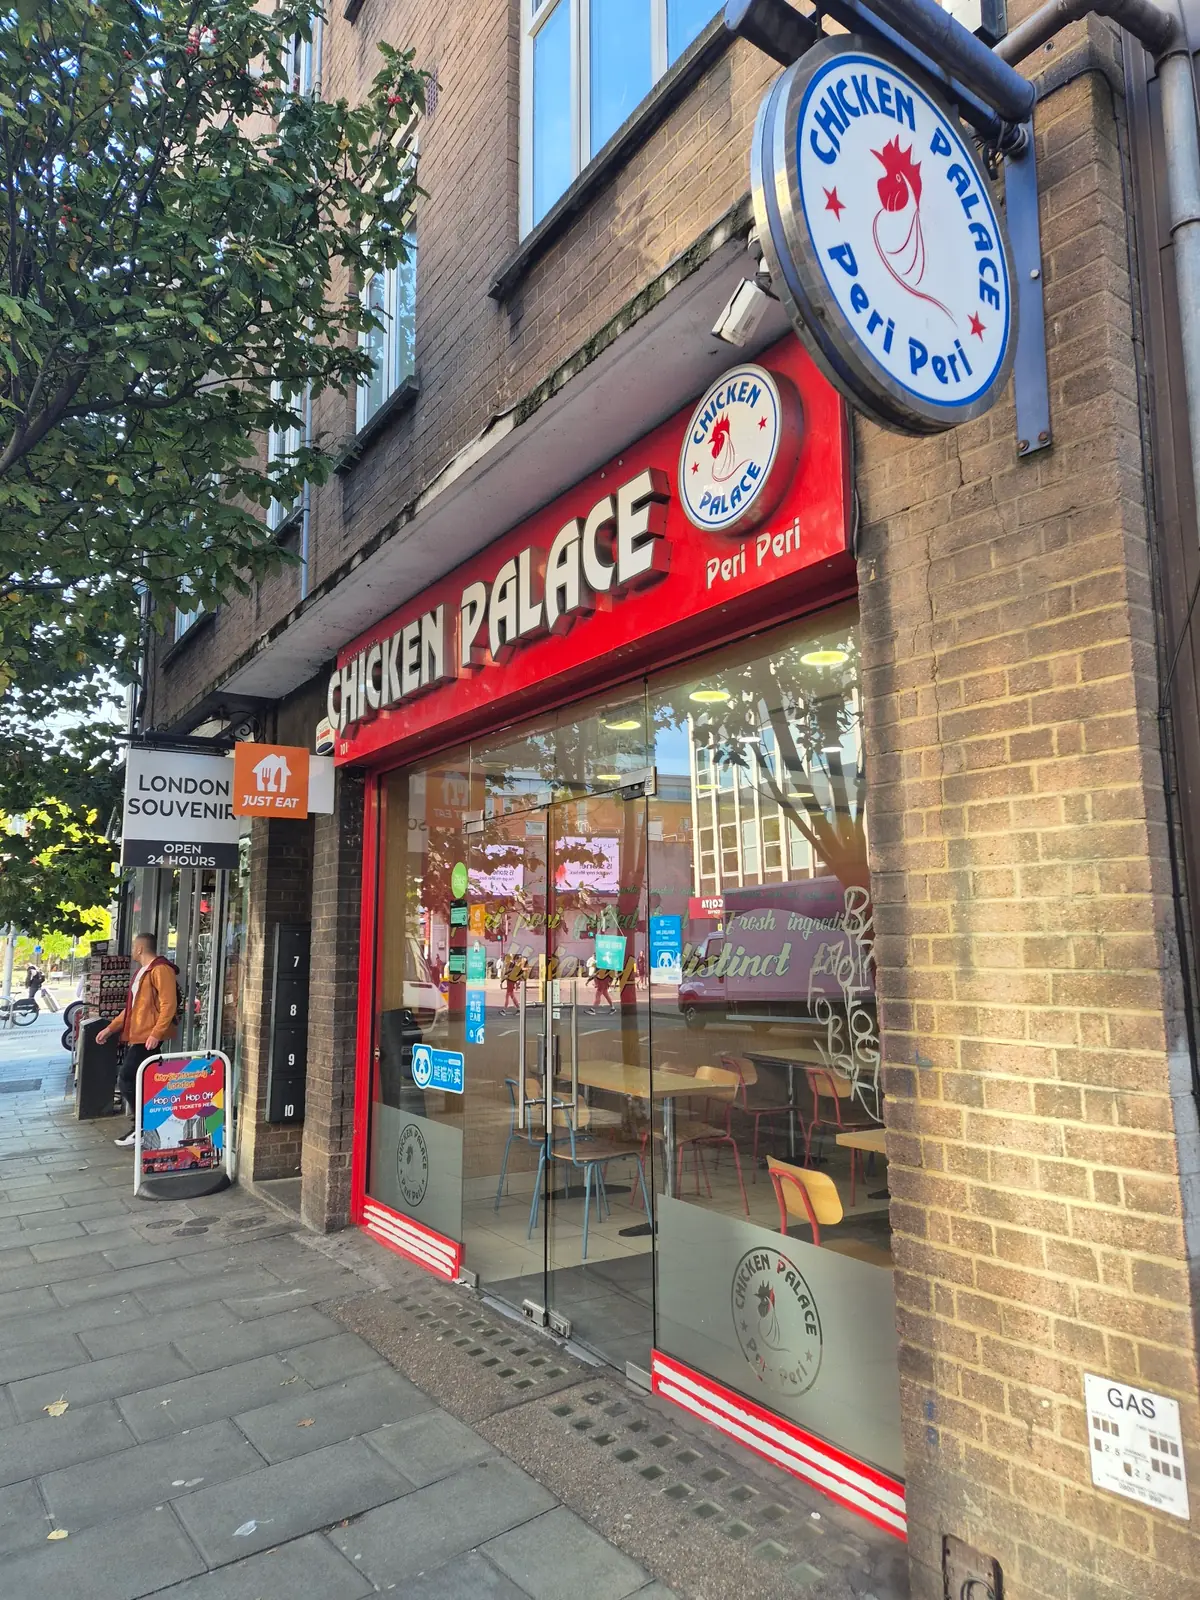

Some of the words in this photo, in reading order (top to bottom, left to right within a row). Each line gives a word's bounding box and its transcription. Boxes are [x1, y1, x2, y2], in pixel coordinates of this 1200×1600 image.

[809, 73, 917, 166] CHICKEN
[929, 126, 1001, 312] PALACE
[827, 241, 895, 356] Peri
[908, 337, 974, 385] Peri
[692, 381, 763, 445] CHICKEN
[698, 460, 761, 517] PALACE
[706, 543, 746, 590] Peri
[755, 516, 801, 568] Peri
[326, 603, 446, 738] CHICKEN
[460, 467, 656, 669] PALACE
[138, 774, 231, 797] LONDON
[127, 798, 237, 821] SOUVENIR
[241, 795, 274, 808] JUST
[274, 797, 300, 809] EAT
[146, 854, 165, 865] 24
[168, 855, 216, 867] HOURS
[163, 843, 202, 855] OPEN
[293, 956, 300, 968] 7
[289, 1004, 297, 1017] 8
[288, 1053, 295, 1066] 9
[153, 1097, 169, 1105] Hop
[170, 1095, 181, 1104] On
[185, 1093, 201, 1102] Hop
[202, 1091, 214, 1100] Off
[284, 1104, 294, 1117] 10
[735, 1253, 771, 1310] CHICKEN
[776, 1258, 818, 1337] PALACE
[746, 1337, 773, 1373] Per
[1107, 1387, 1156, 1419] GAS
